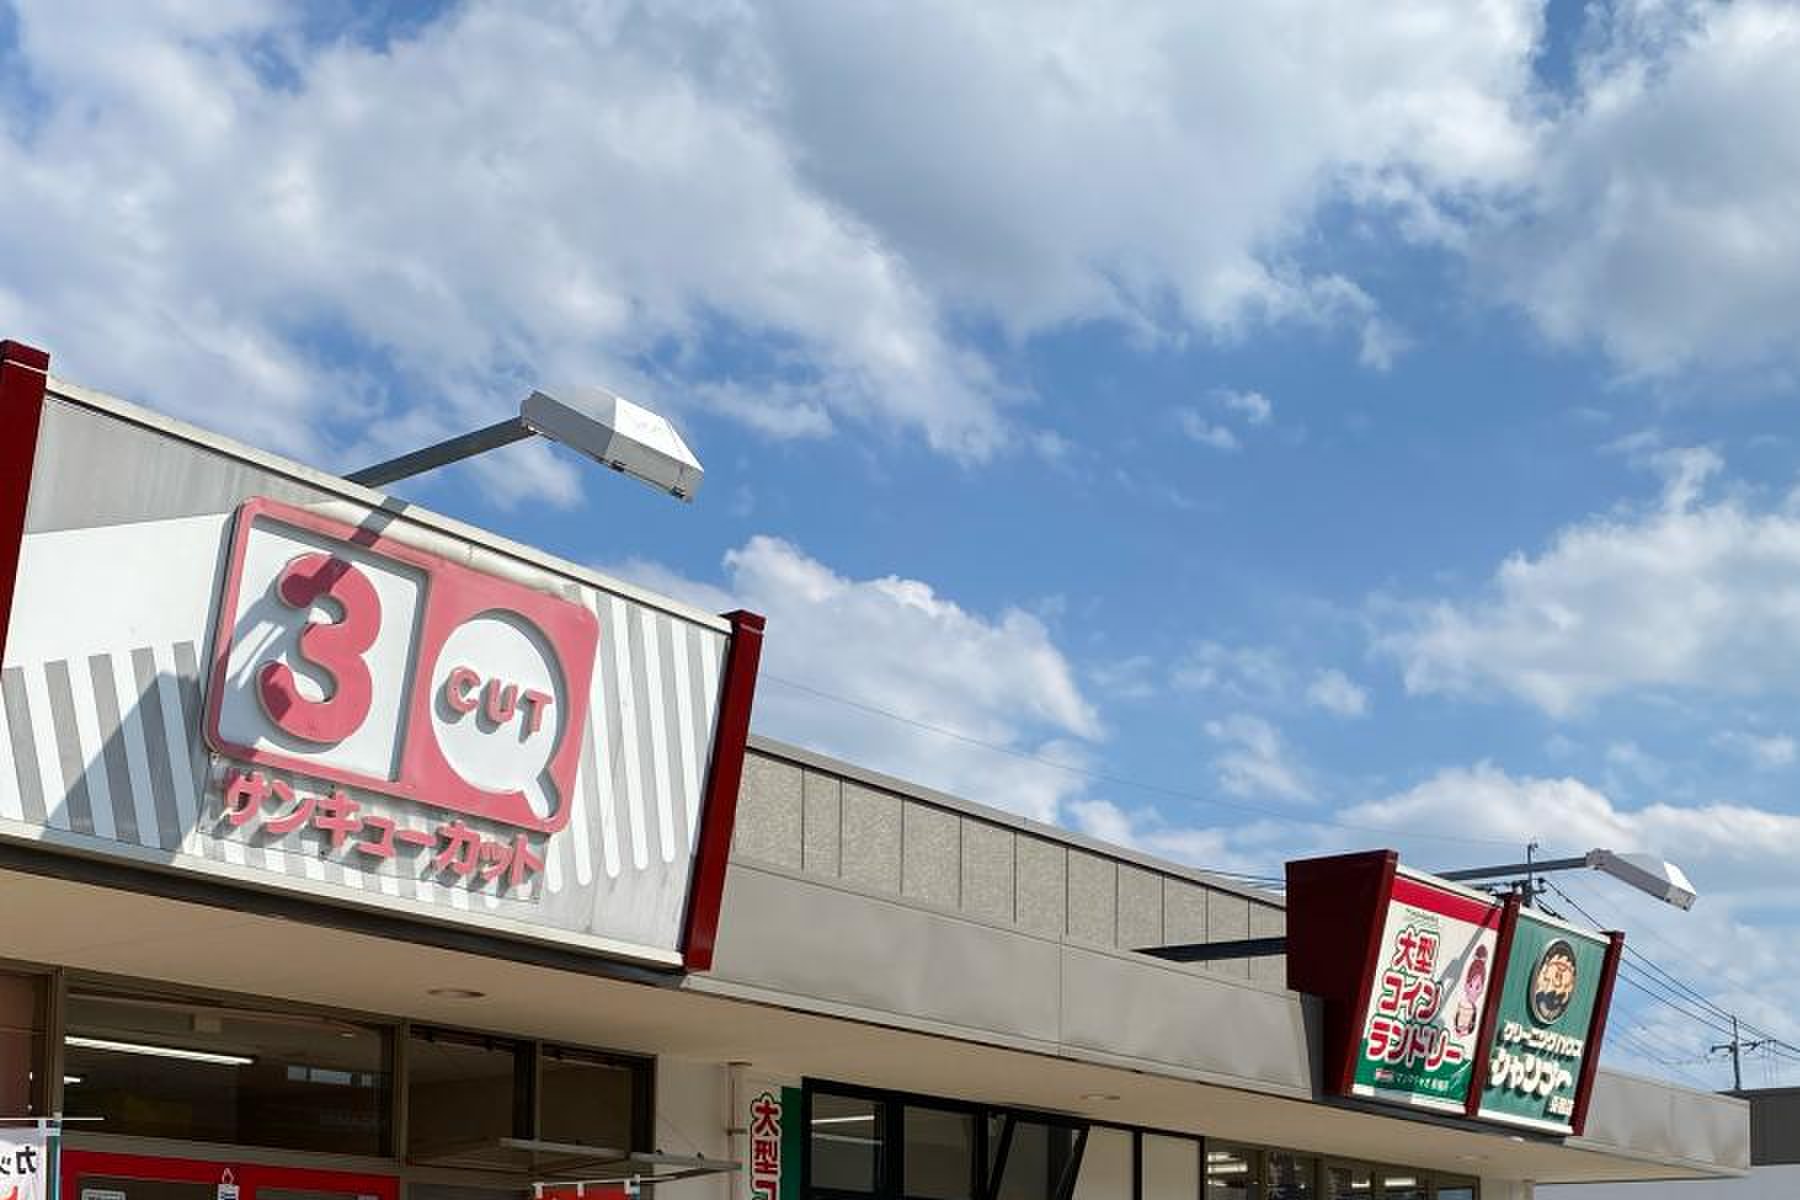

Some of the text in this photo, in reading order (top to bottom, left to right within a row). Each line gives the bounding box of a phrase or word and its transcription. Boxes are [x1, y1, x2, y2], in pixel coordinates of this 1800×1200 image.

[446, 665, 556, 736] CUT
[224, 768, 545, 890] サンキューカット
[1392, 928, 1440, 976] 大型
[1377, 970, 1442, 1022] コイン
[1365, 1016, 1464, 1070] ランドリー
